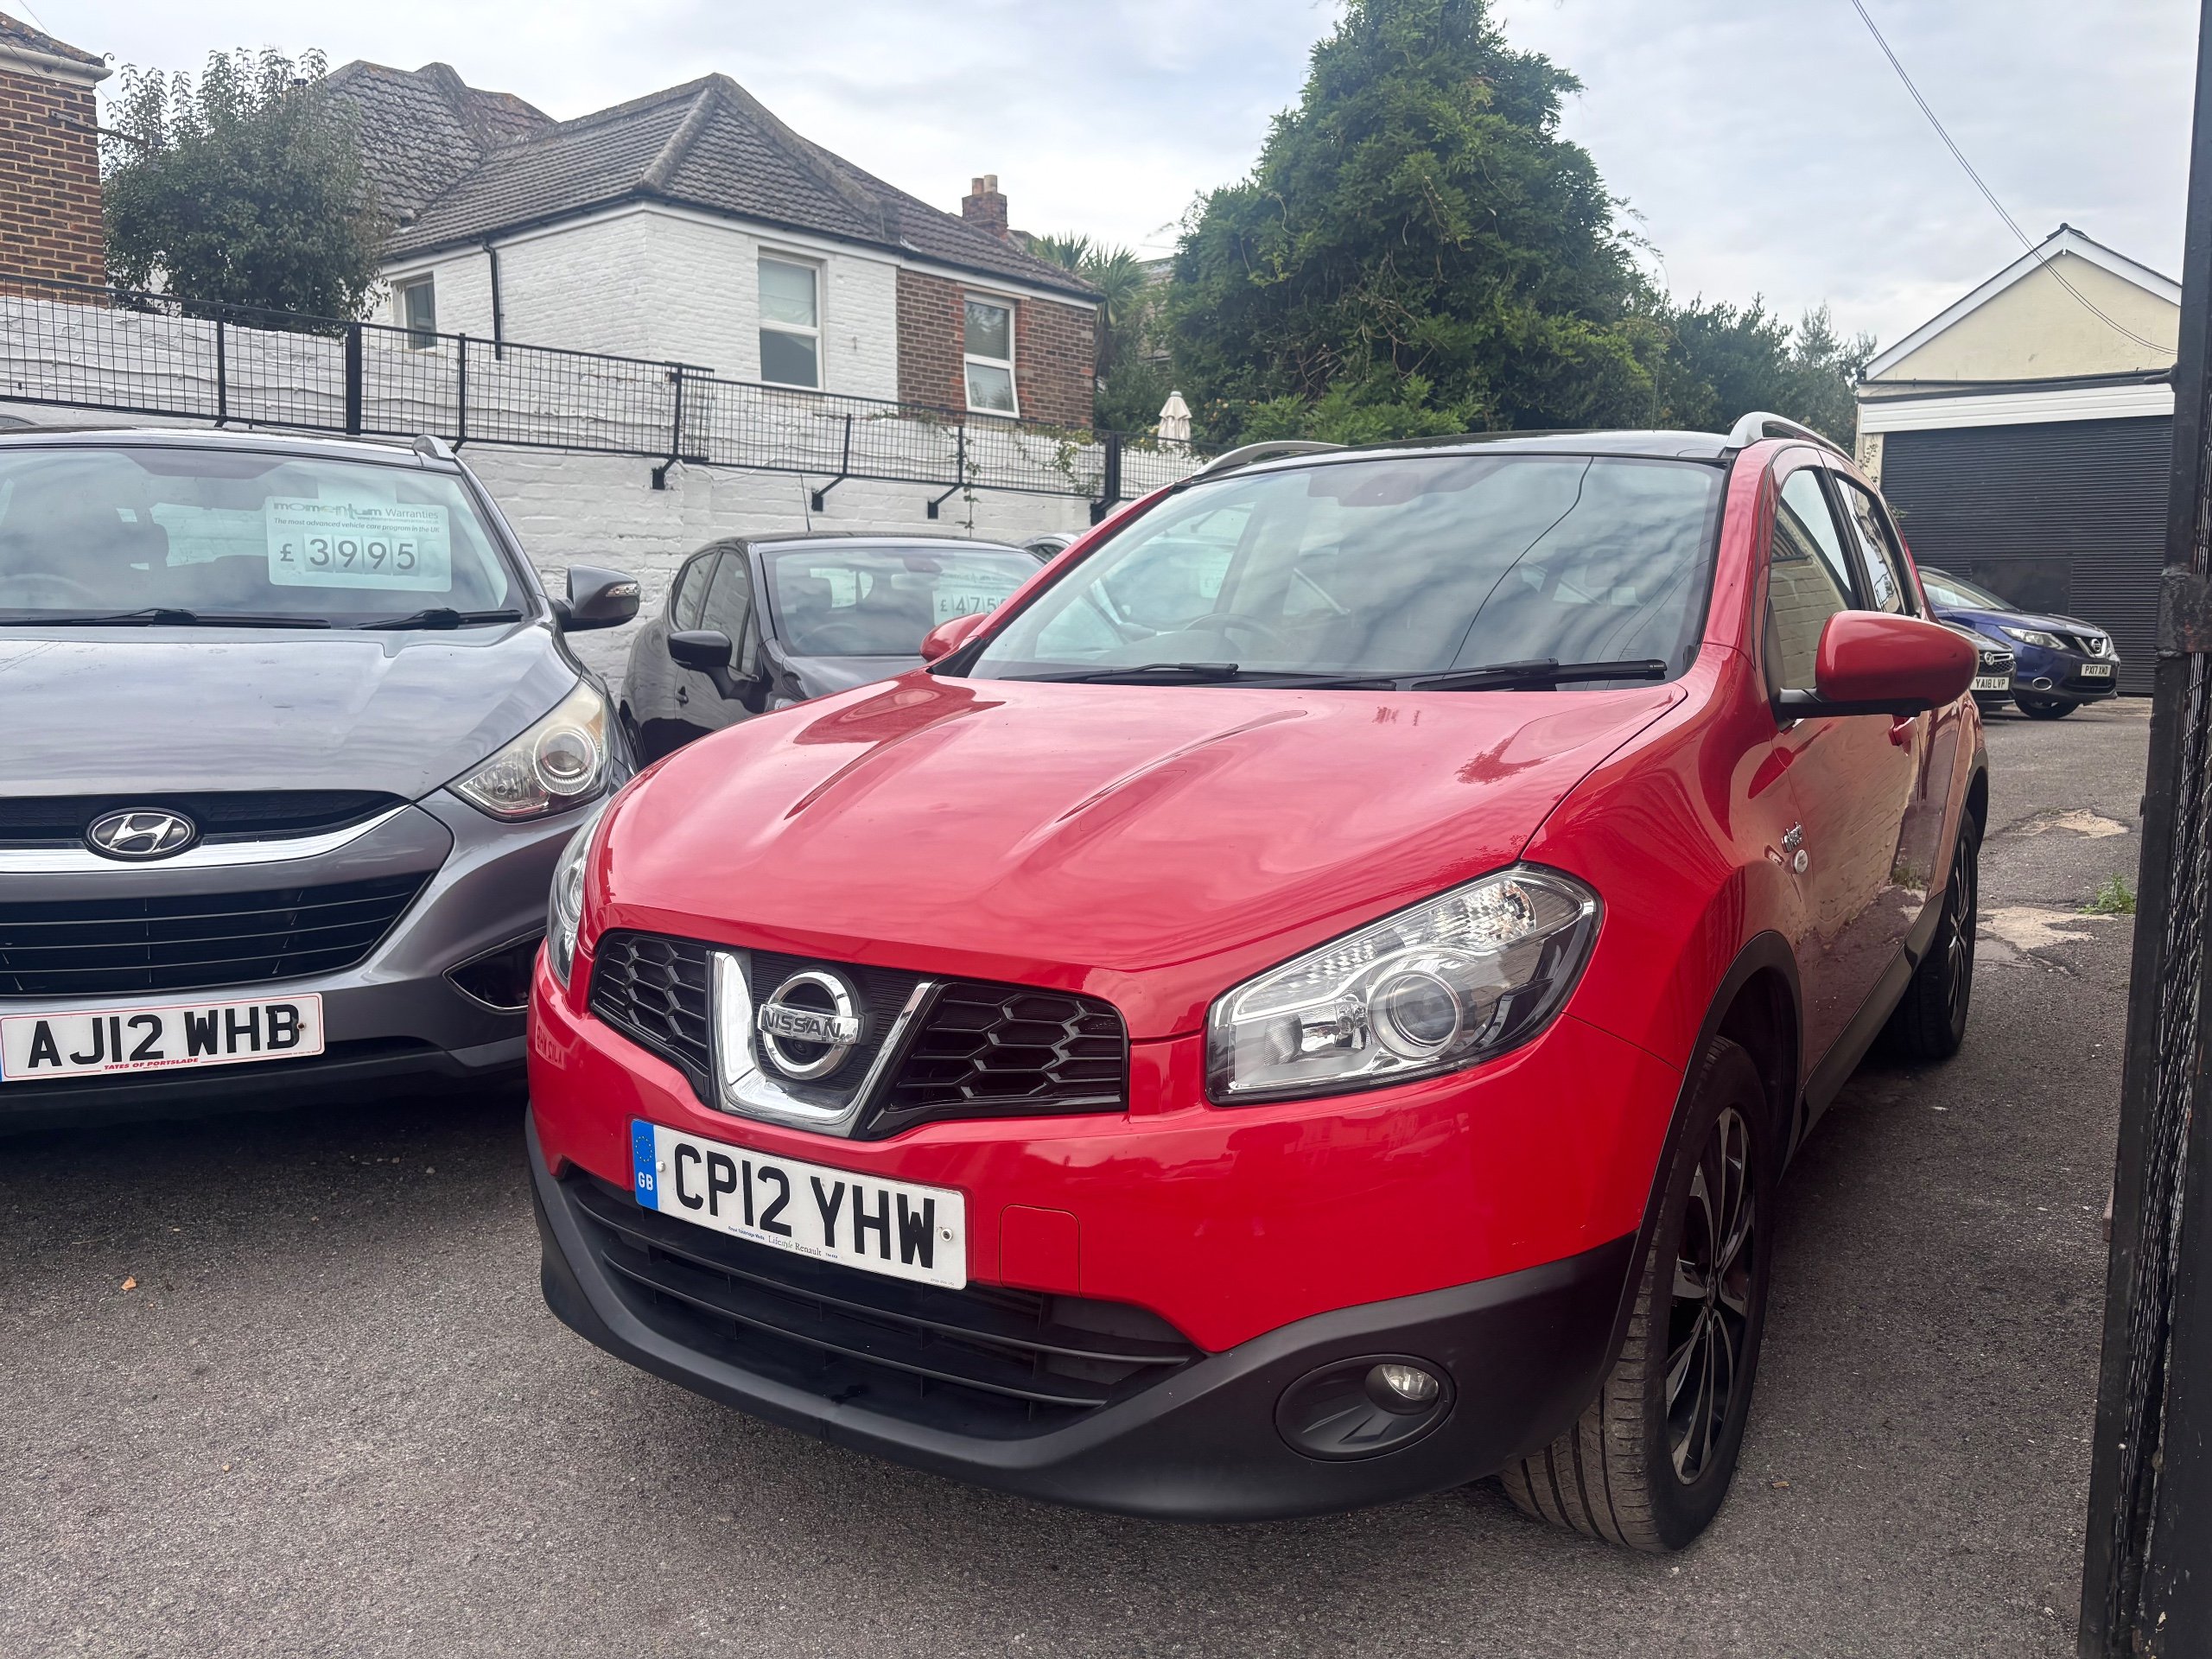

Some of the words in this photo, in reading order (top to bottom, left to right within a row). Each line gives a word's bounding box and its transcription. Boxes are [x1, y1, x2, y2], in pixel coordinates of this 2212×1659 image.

[273, 503, 382, 520] momentum
[385, 508, 439, 519] Warranties
[955, 596, 1006, 613] 475
[1993, 678, 2005, 689] LVP
[761, 1010, 842, 1039] NISSAN
[28, 1014, 164, 1068] AJ12
[183, 1004, 300, 1057] WHB
[147, 1058, 199, 1067] PORTSLADE
[638, 1172, 653, 1191] GB
[674, 1143, 792, 1237] CP12
[810, 1176, 935, 1268] YHW
[795, 1243, 823, 1256] Renault
